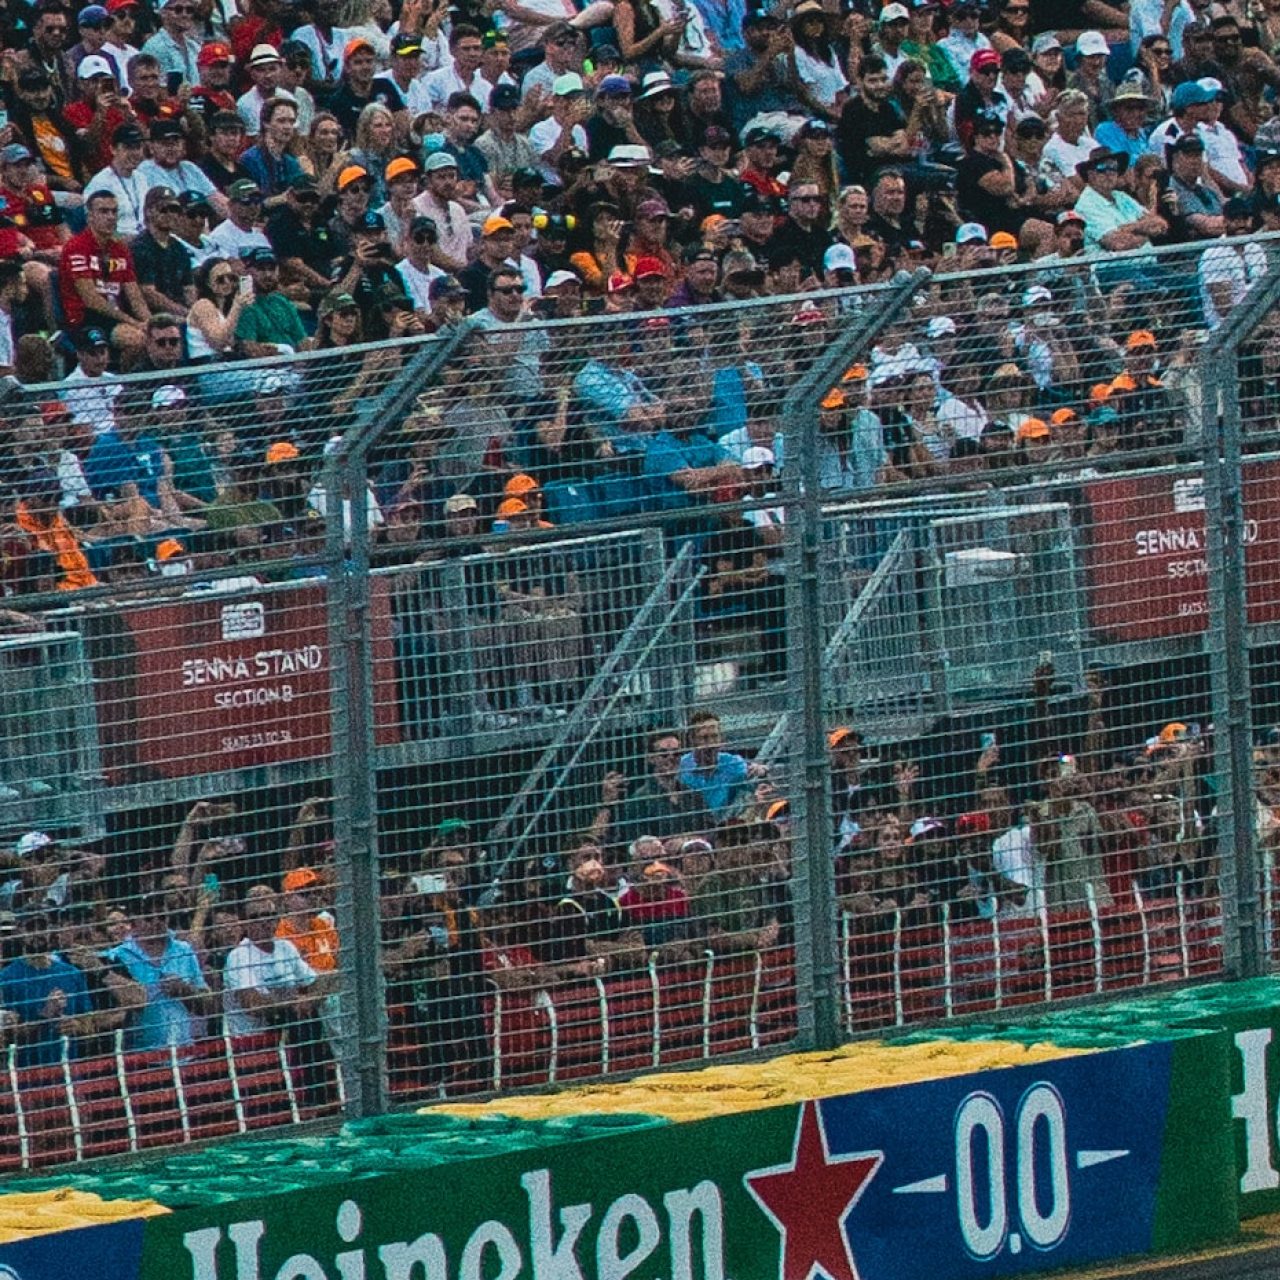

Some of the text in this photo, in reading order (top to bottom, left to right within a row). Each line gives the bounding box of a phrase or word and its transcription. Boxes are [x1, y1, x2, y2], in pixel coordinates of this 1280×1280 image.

[1136, 526, 1199, 555] SENNA
[183, 645, 322, 685] SENNA STAND
[214, 687, 279, 707] SECTION
[954, 1081, 1070, 1261] 0.0
